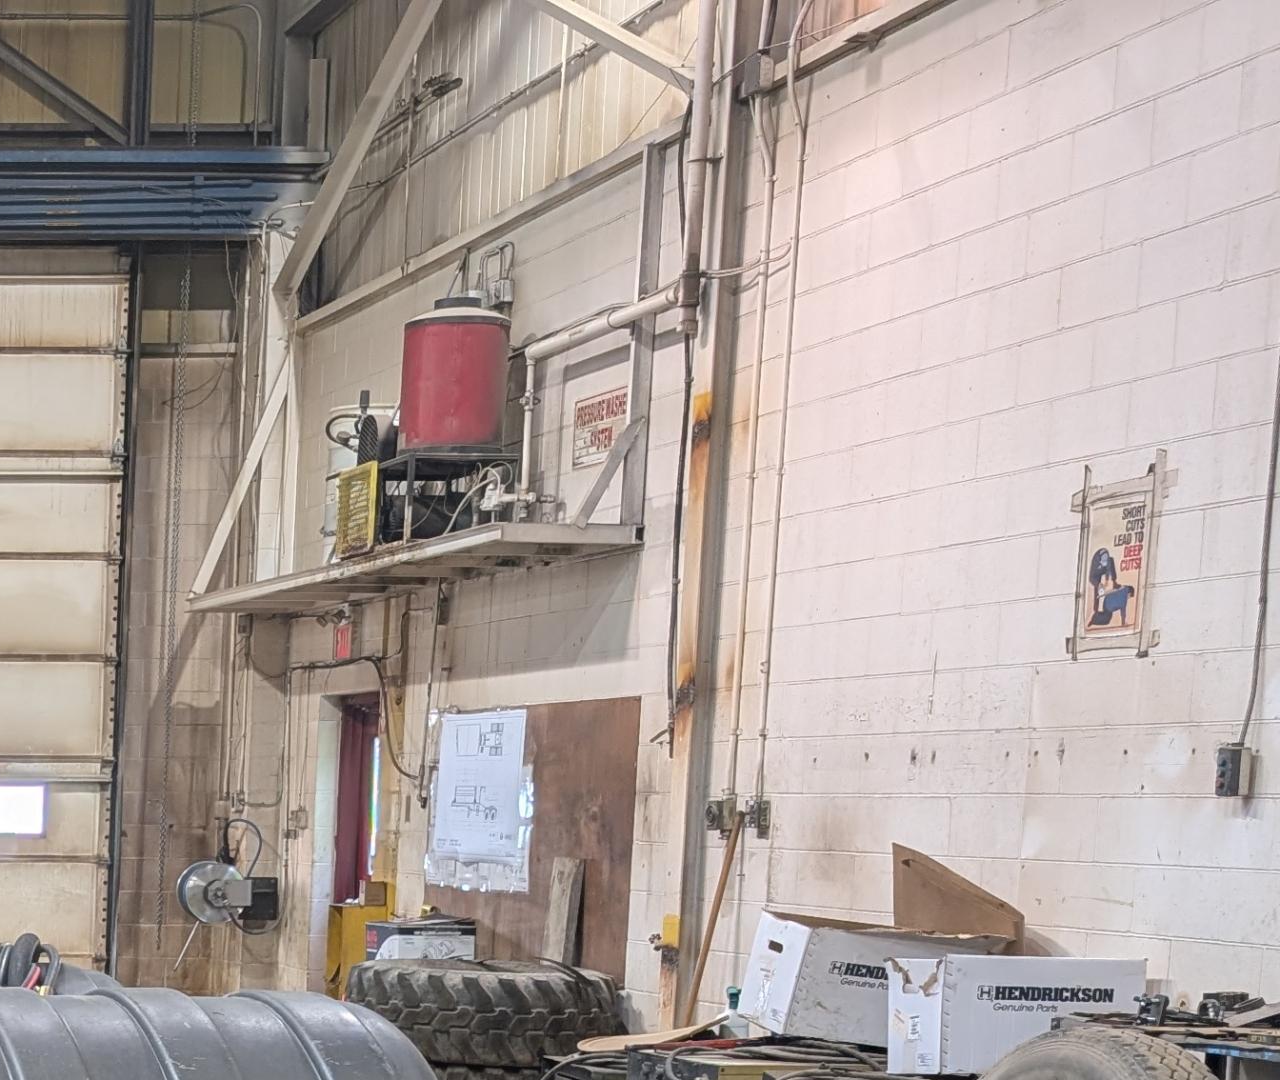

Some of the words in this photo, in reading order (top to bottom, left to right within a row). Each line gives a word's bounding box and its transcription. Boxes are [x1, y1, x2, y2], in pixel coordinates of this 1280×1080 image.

[605, 391, 628, 420] WASHE
[1122, 504, 1146, 520] SHORT
[1126, 518, 1145, 532] CUTS
[1114, 533, 1132, 547] LEAD
[1134, 531, 1144, 544] TO
[1123, 544, 1143, 558] DEEP
[840, 977, 877, 988] Genuine
[994, 985, 1115, 1003] HENDRICKSON
[992, 1002, 1035, 1012] Genuine
[1035, 1003, 1058, 1013] Parts
